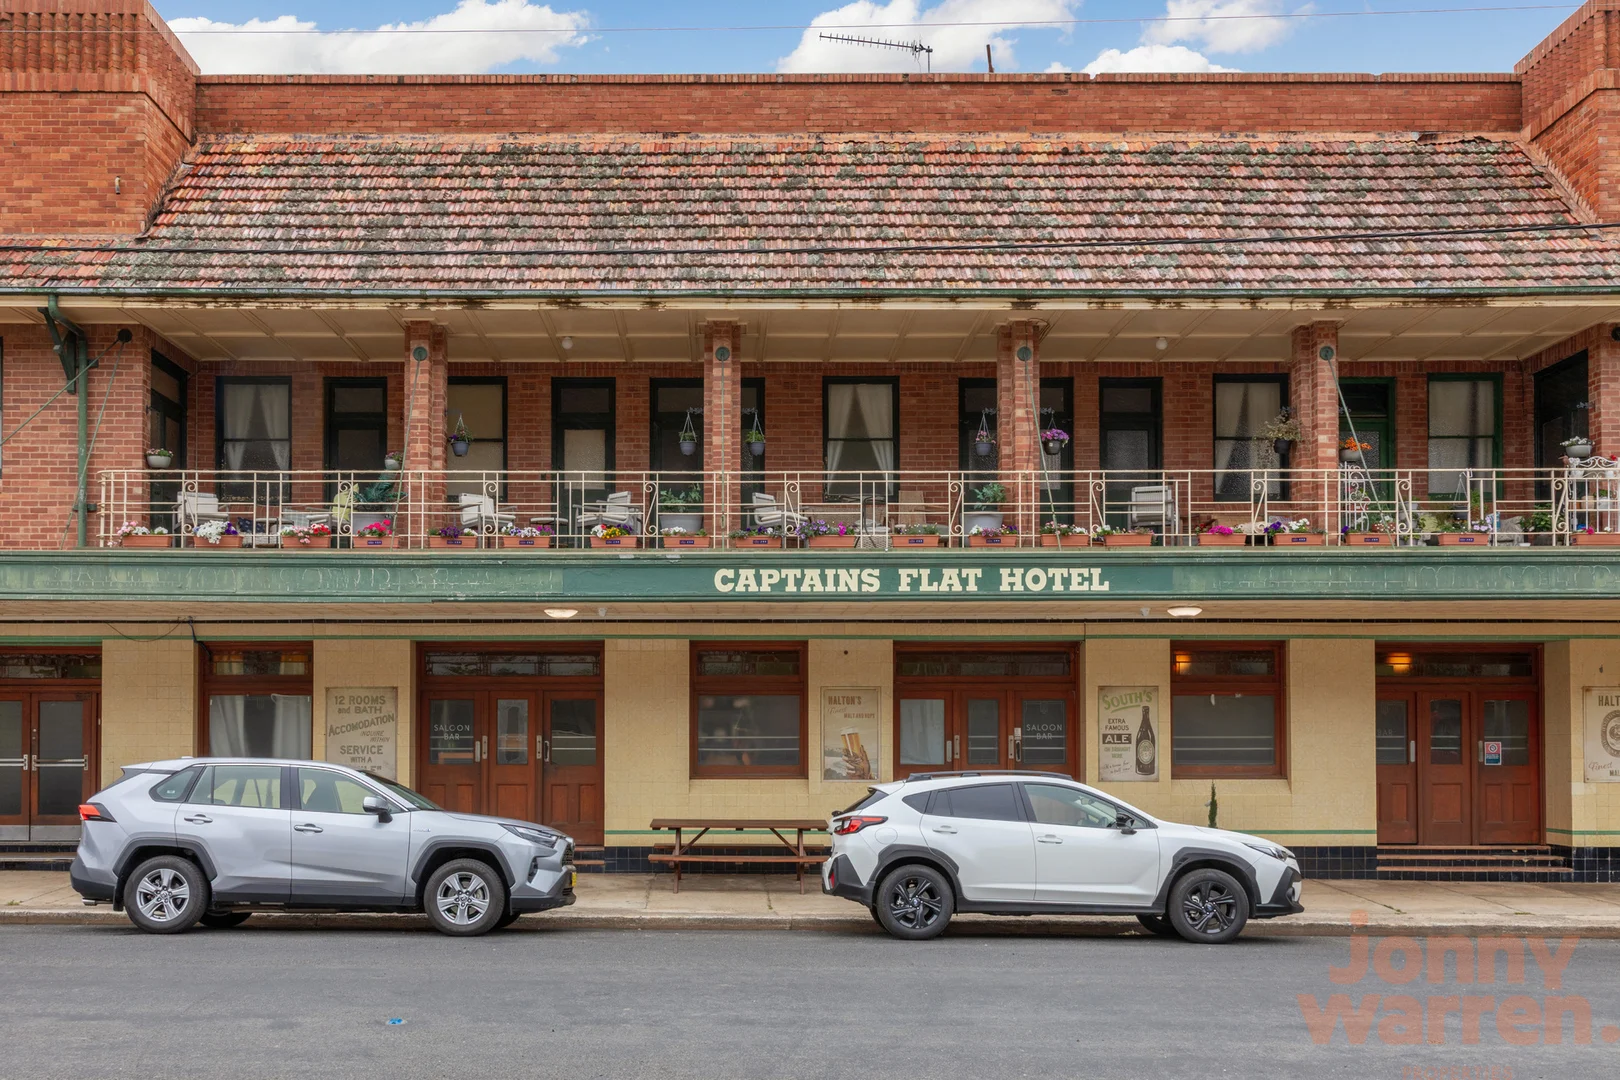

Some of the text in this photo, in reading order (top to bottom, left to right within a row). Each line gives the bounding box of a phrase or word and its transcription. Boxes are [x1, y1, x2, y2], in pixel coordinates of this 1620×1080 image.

[714, 567, 1109, 593] CAPTAINS FLAT HOTEL
[334, 695, 386, 705] 12 ROOMS
[828, 696, 862, 705] HALTON'S
[1102, 690, 1153, 711] SOUTH'S
[354, 705, 383, 714] BATH
[433, 724, 470, 732] SALOON
[1026, 723, 1063, 731] SALOON
[443, 733, 460, 741] BAR
[1036, 732, 1053, 740] BAR
[1105, 734, 1130, 743] ALE
[339, 745, 384, 755] SERVICE
